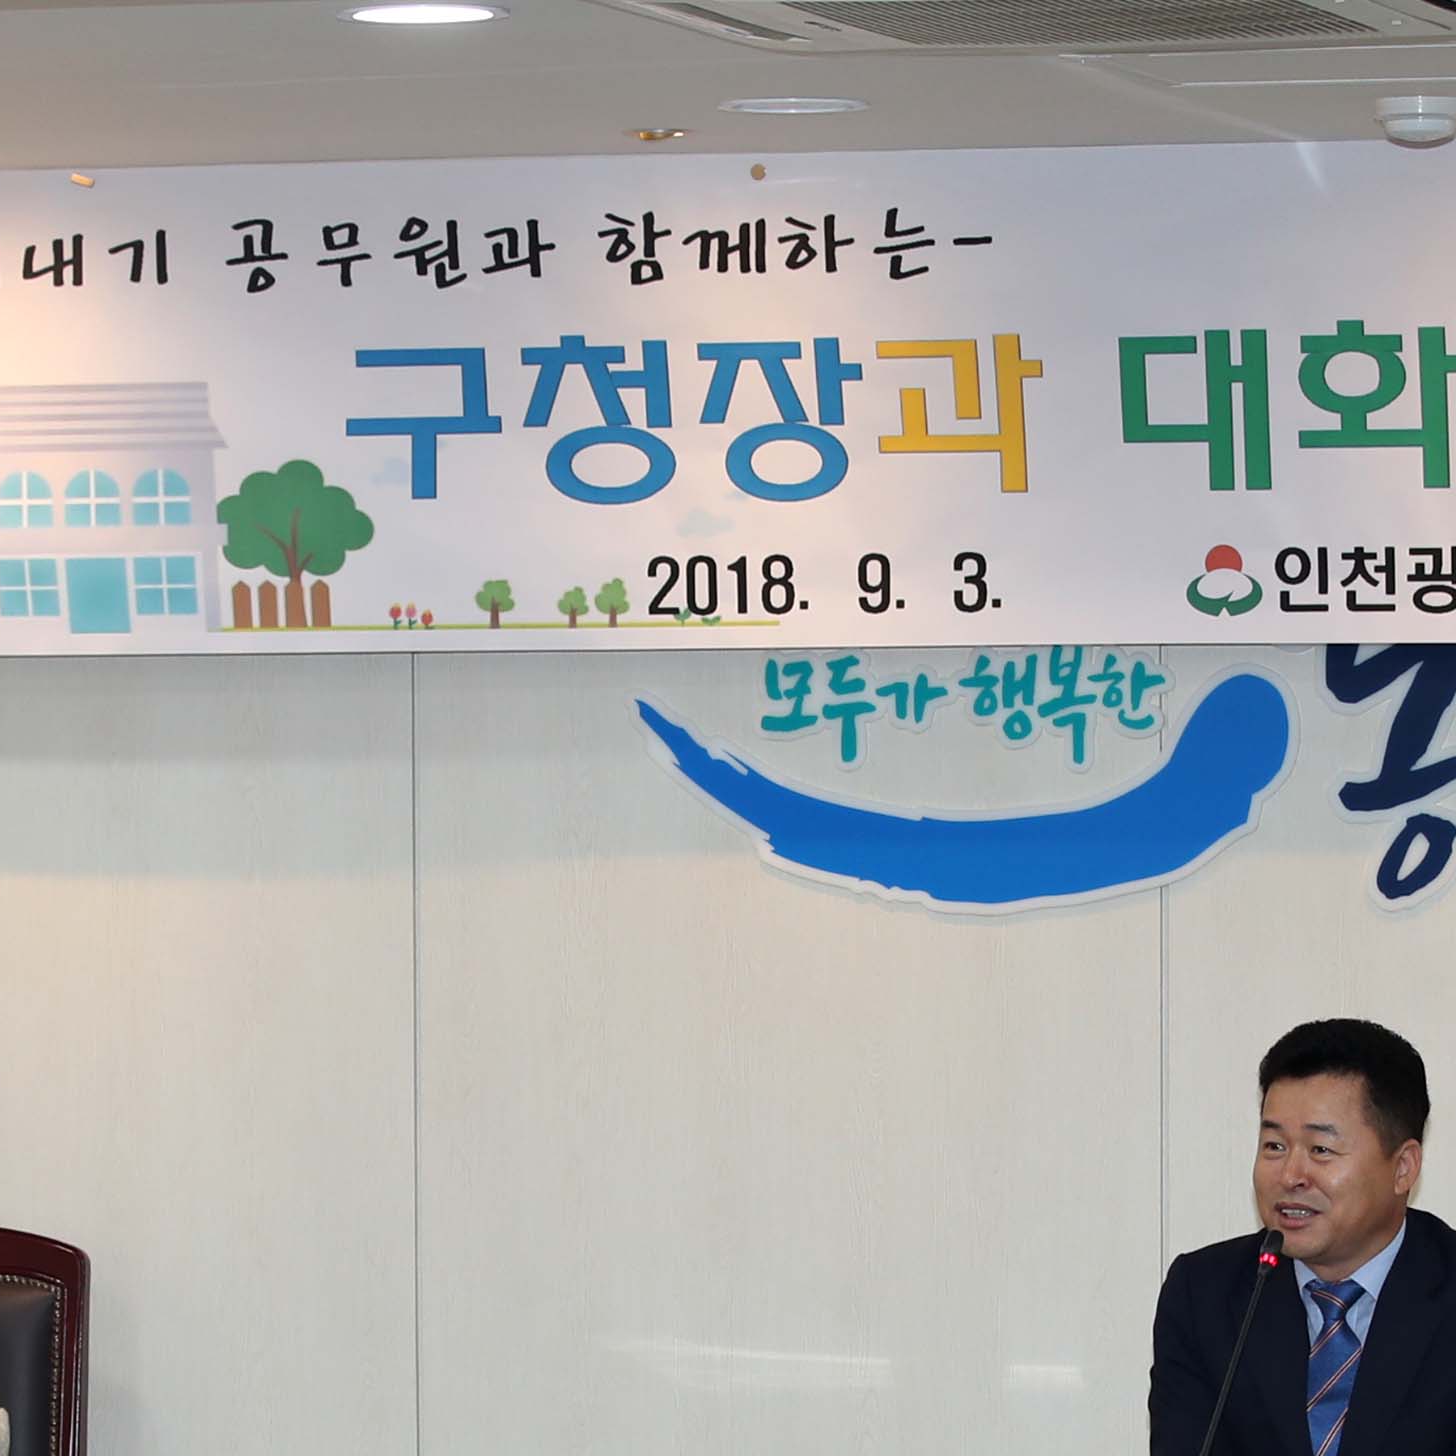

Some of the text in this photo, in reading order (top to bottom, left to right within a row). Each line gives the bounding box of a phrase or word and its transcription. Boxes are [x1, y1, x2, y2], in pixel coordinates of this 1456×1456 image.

[225, 216, 557, 294] 공무원과
[344, 333, 1043, 504] 구청장과
[646, 550, 1003, 617] 2018. 9. 3.
[761, 655, 948, 763] 모두가
[958, 645, 1166, 765] 행복한
